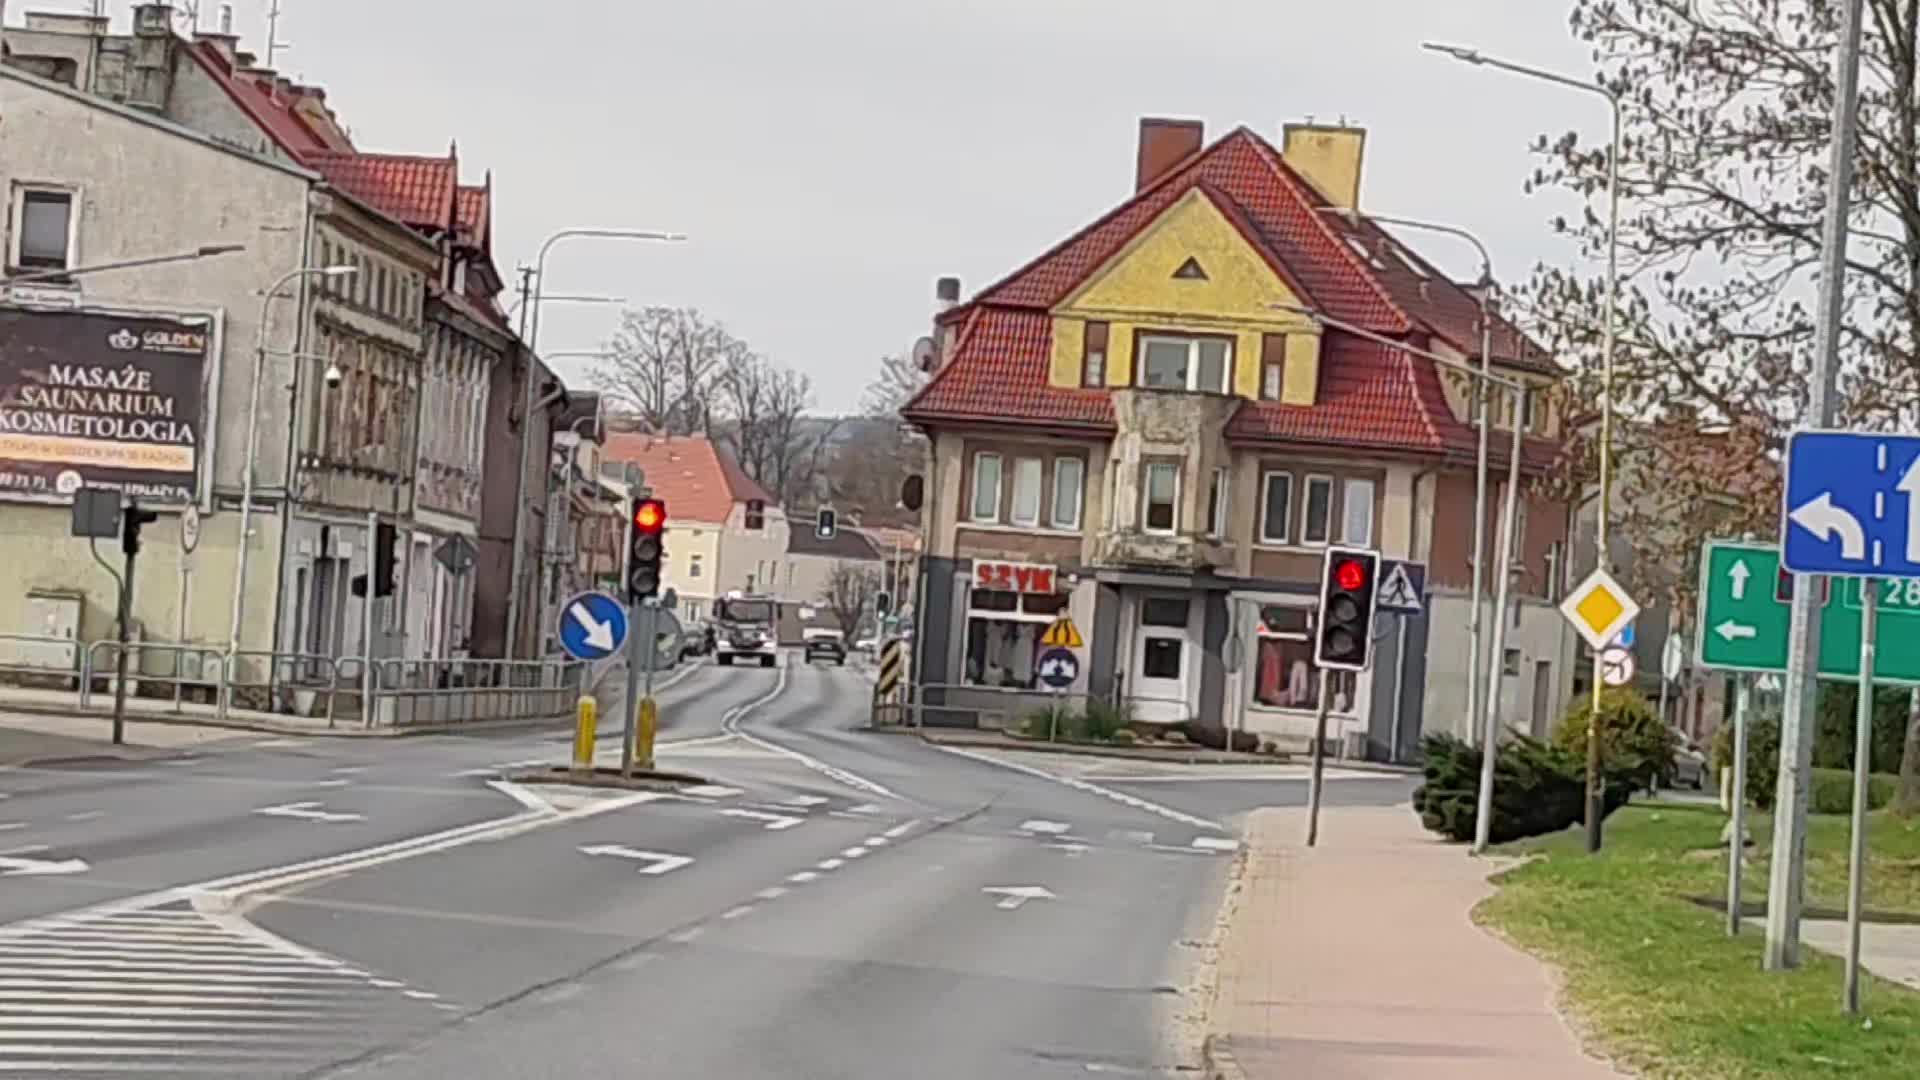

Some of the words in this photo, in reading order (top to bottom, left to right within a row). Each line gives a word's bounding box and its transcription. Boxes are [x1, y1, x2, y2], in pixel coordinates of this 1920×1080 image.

[143, 331, 204, 348] GOLDEN
[48, 364, 151, 391] MASAŻE
[20, 386, 173, 417] SAUNARIUM
[0, 409, 194, 443] KOSMETOLOGIA
[977, 563, 1052, 590] SZYK
